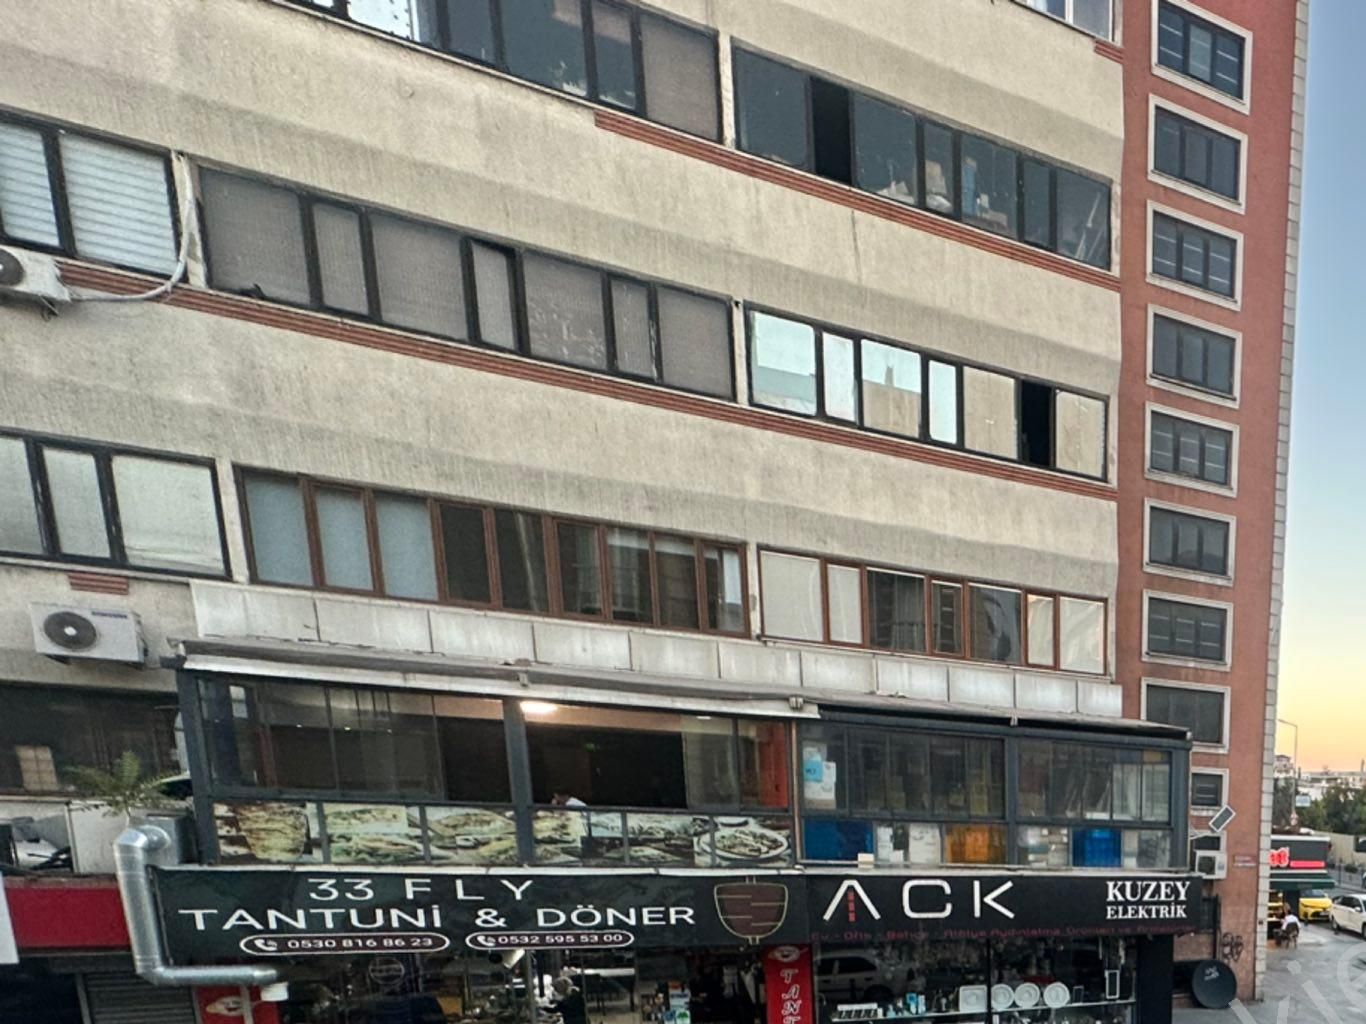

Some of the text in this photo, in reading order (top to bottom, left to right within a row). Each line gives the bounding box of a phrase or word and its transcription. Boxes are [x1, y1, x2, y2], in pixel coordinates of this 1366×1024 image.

[308, 878, 533, 900] 33 FLY
[1106, 880, 1191, 902] KUZEY
[823, 879, 1015, 922] ACK
[1106, 902, 1187, 920] ELEKTRİK
[178, 904, 696, 931] TANTUNİ & DÖNER
[287, 937, 433, 950] 0530 816 86 23
[498, 934, 541, 945] 0532
[545, 934, 576, 944] 595
[579, 933, 600, 944] 53
